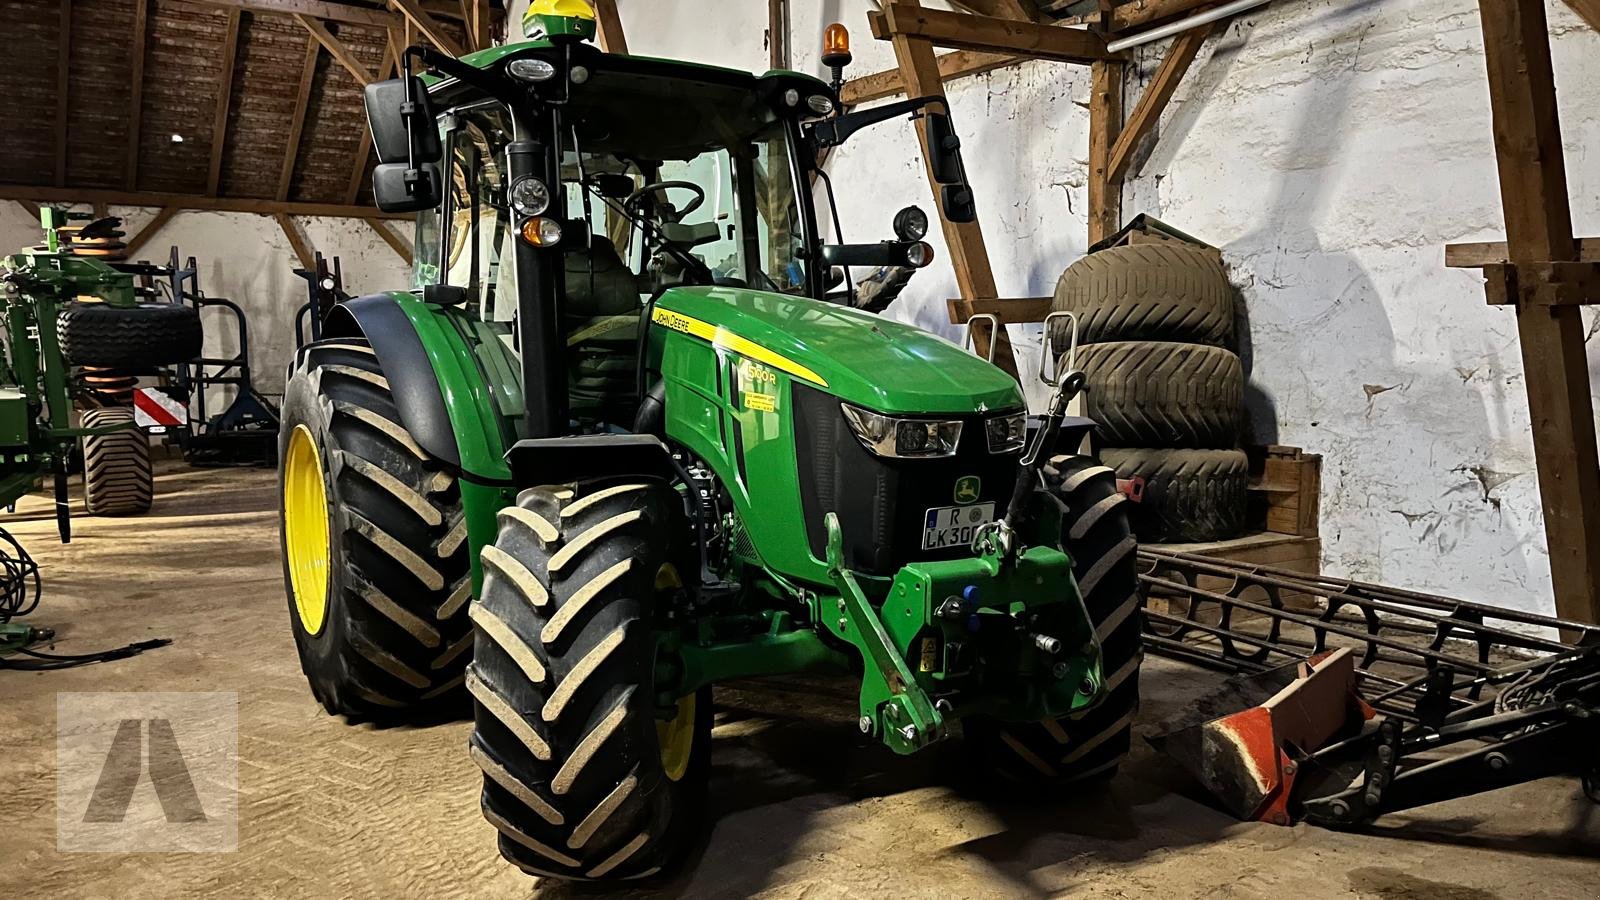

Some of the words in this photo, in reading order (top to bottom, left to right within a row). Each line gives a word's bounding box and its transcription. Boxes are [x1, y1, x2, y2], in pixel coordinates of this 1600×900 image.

[656, 311, 670, 325] JOHN
[670, 314, 690, 332] DEERE
[950, 509, 960, 525] R
